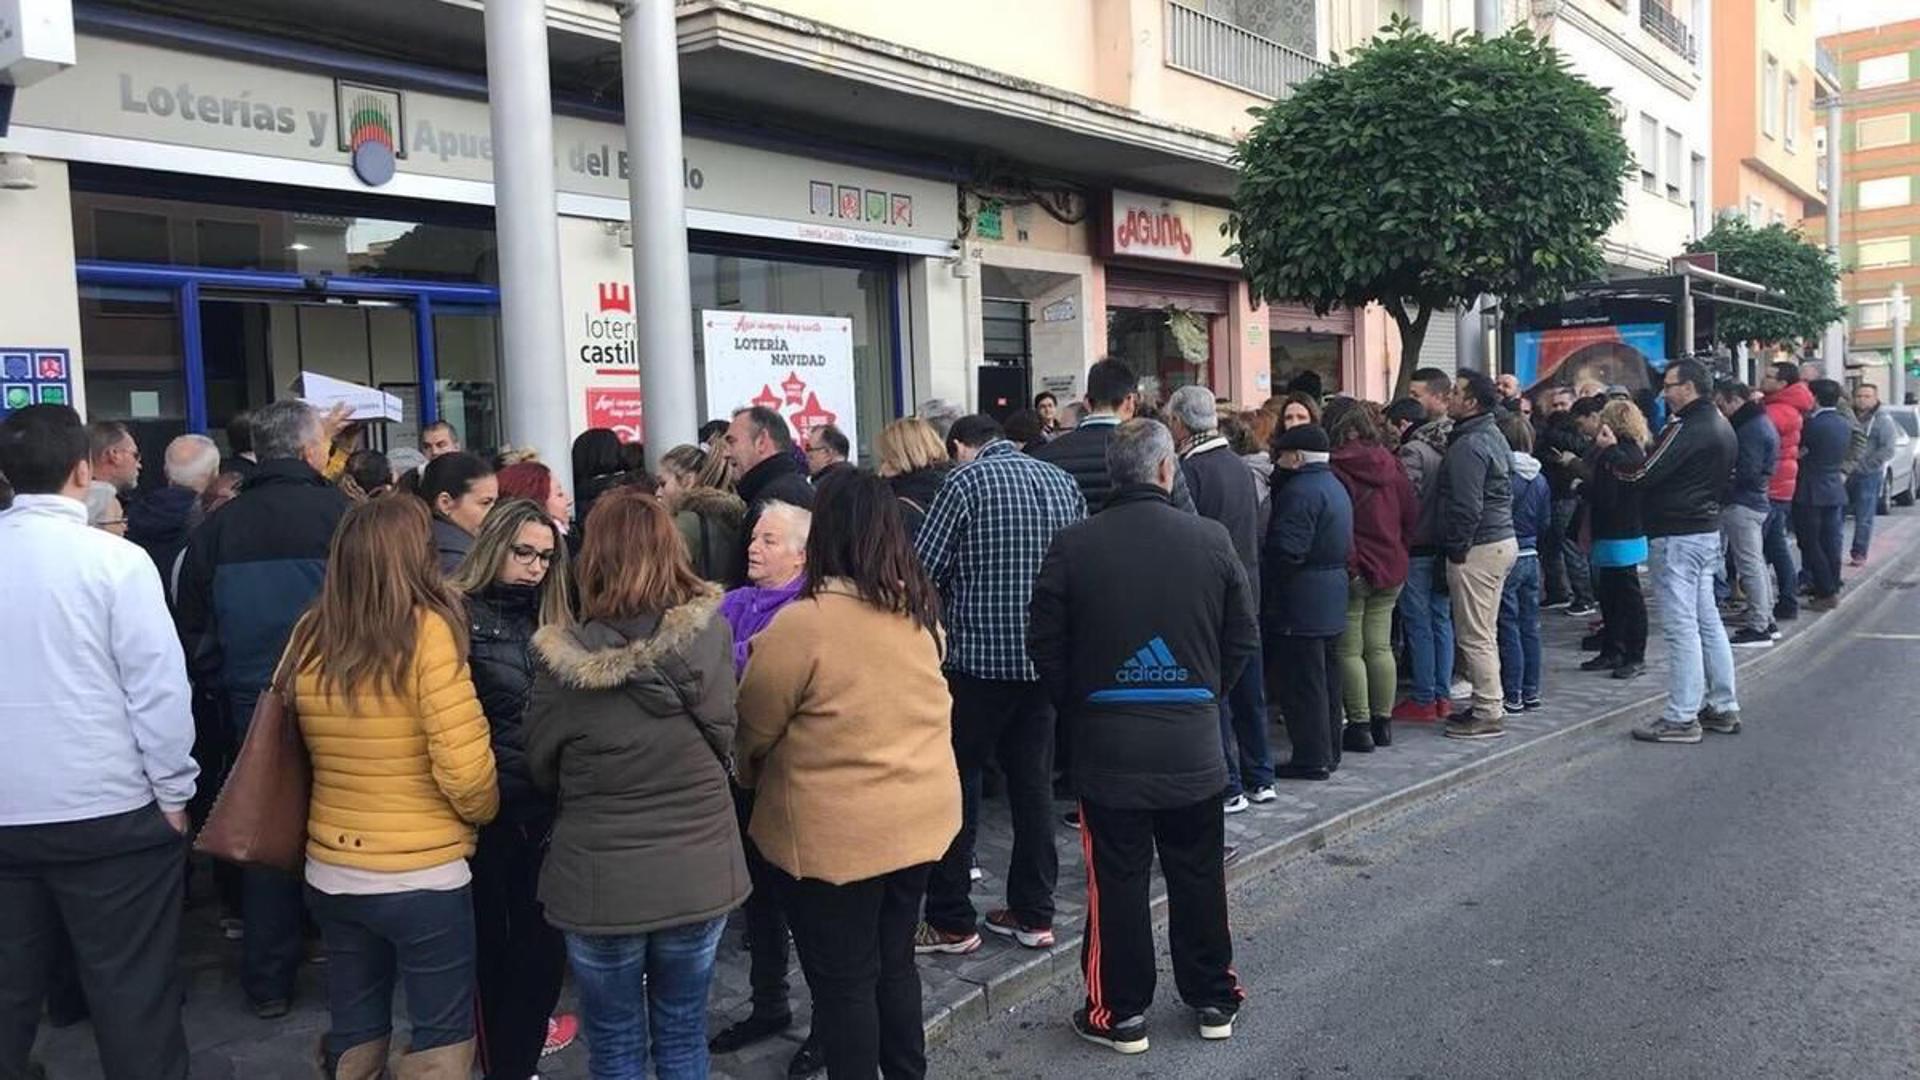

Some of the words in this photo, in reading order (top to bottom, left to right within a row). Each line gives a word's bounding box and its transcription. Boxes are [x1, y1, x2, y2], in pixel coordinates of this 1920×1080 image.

[118, 73, 296, 134] Loterías
[307, 109, 329, 147] y
[569, 140, 609, 177] del
[735, 335, 789, 351] LOTERÍA
[580, 341, 639, 364] castil
[771, 354, 826, 367] NAVIDAD
[1115, 665, 1189, 682] adidas
